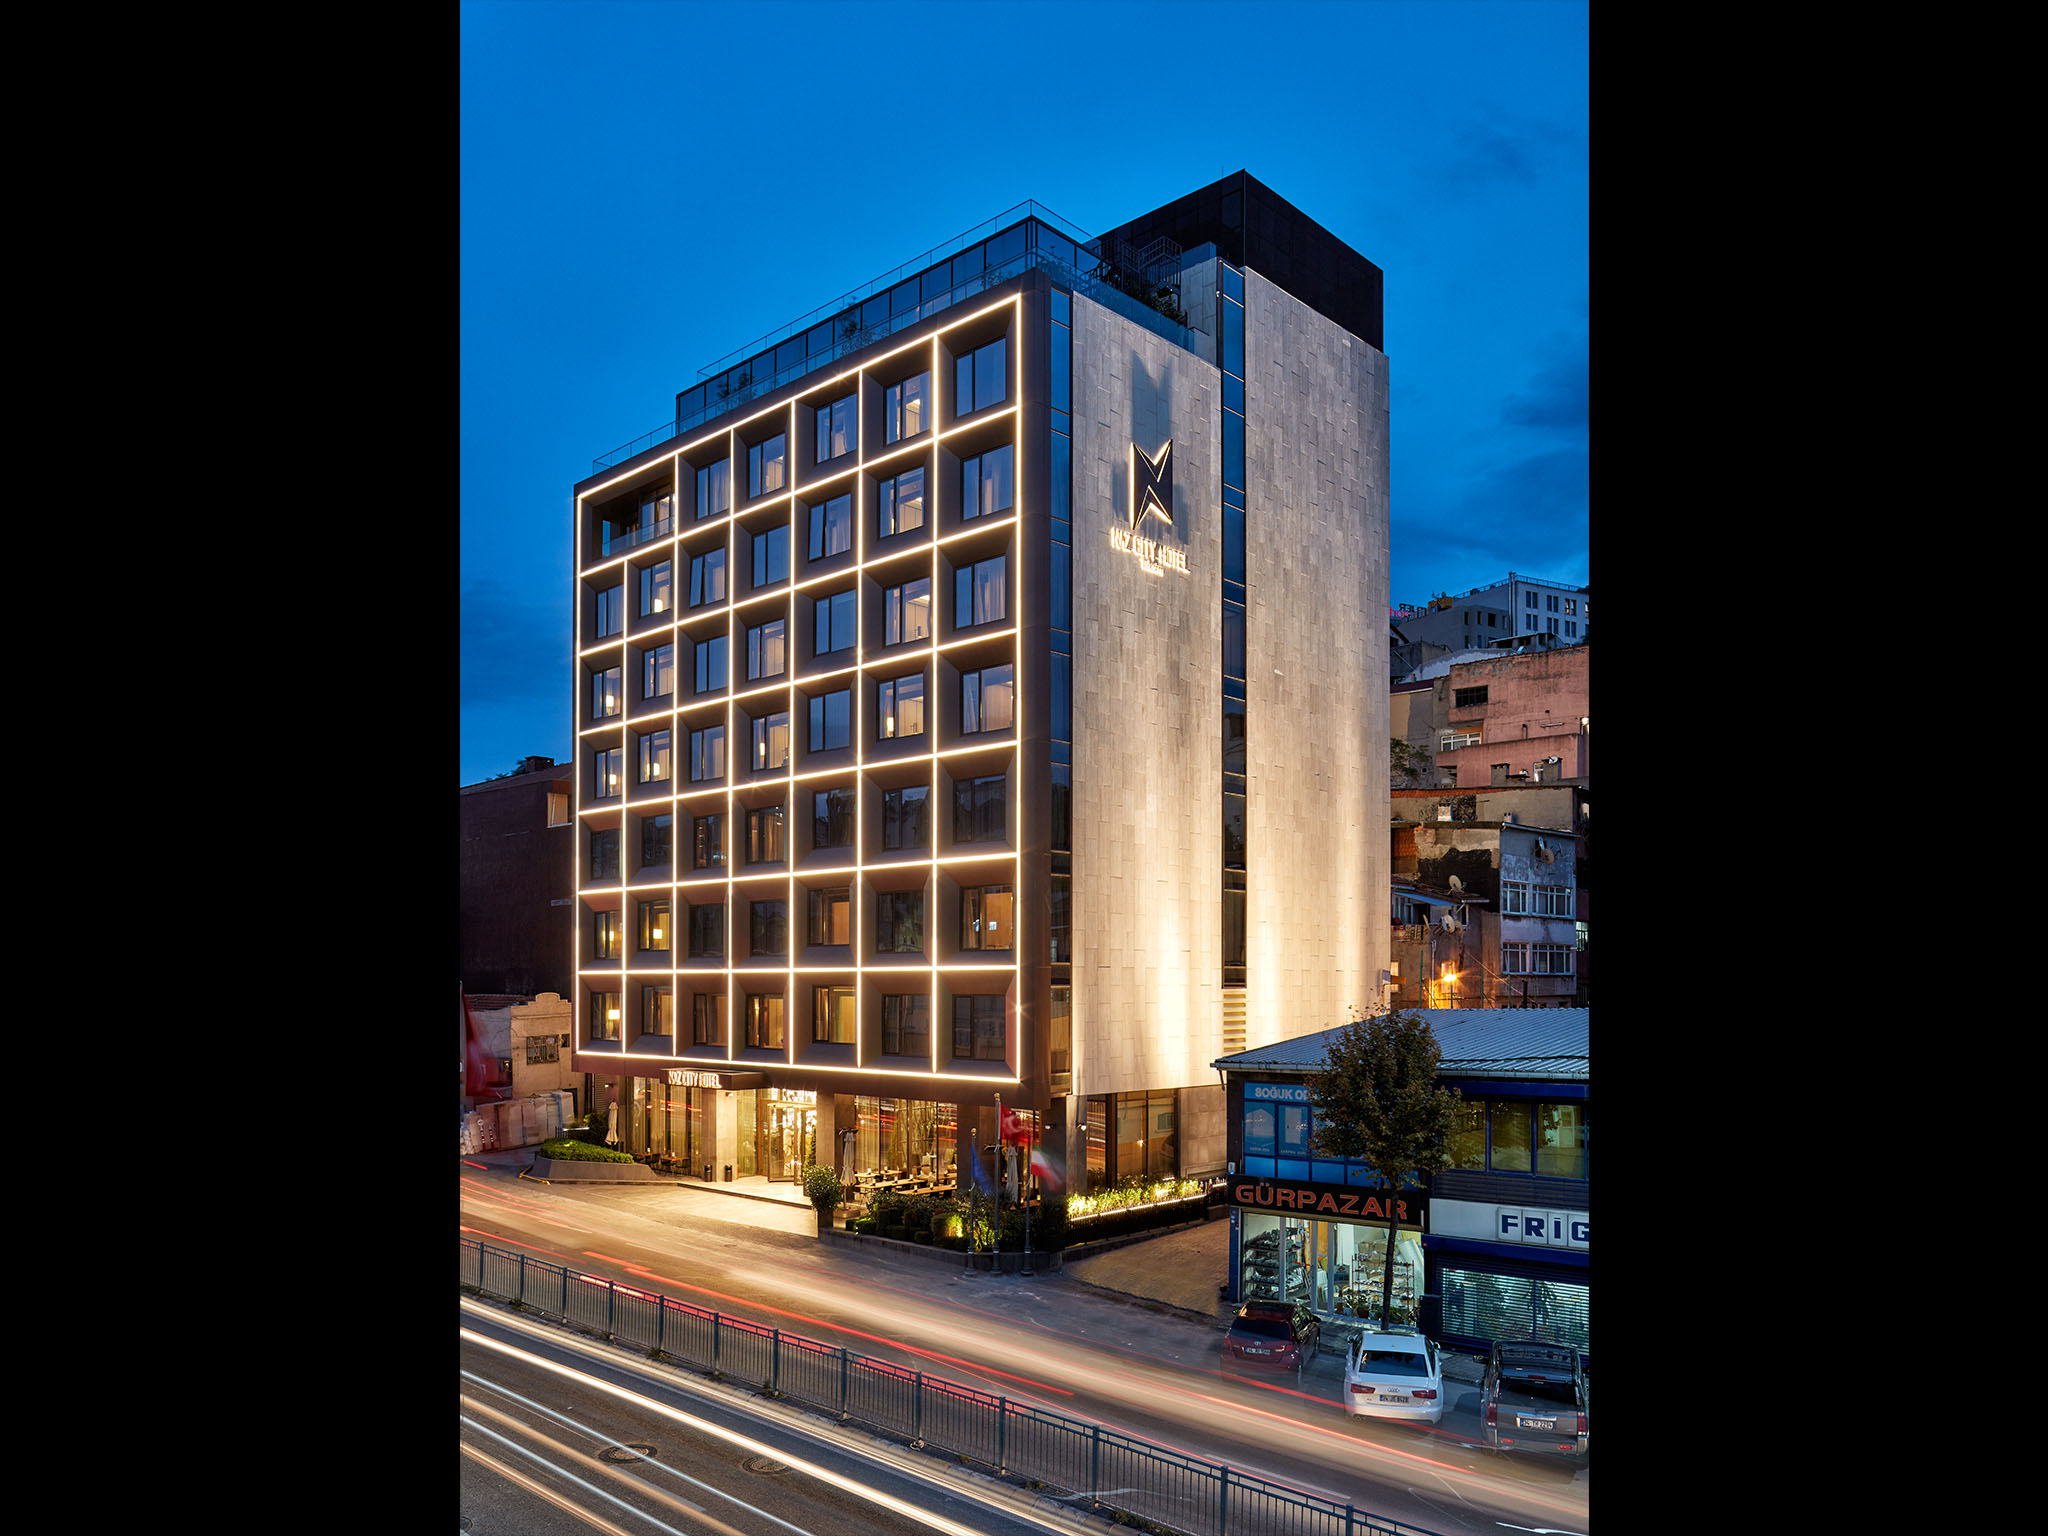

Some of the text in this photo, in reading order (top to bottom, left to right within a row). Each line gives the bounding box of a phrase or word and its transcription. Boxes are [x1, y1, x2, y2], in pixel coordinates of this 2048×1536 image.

[1132, 535, 1157, 562] CITY
[1157, 544, 1191, 574] HOTEL
[699, 1072, 722, 1089] HOTEL
[1235, 1182, 1408, 1220] GÜRPAZAR
[1501, 1214, 1590, 1242] FRİG
